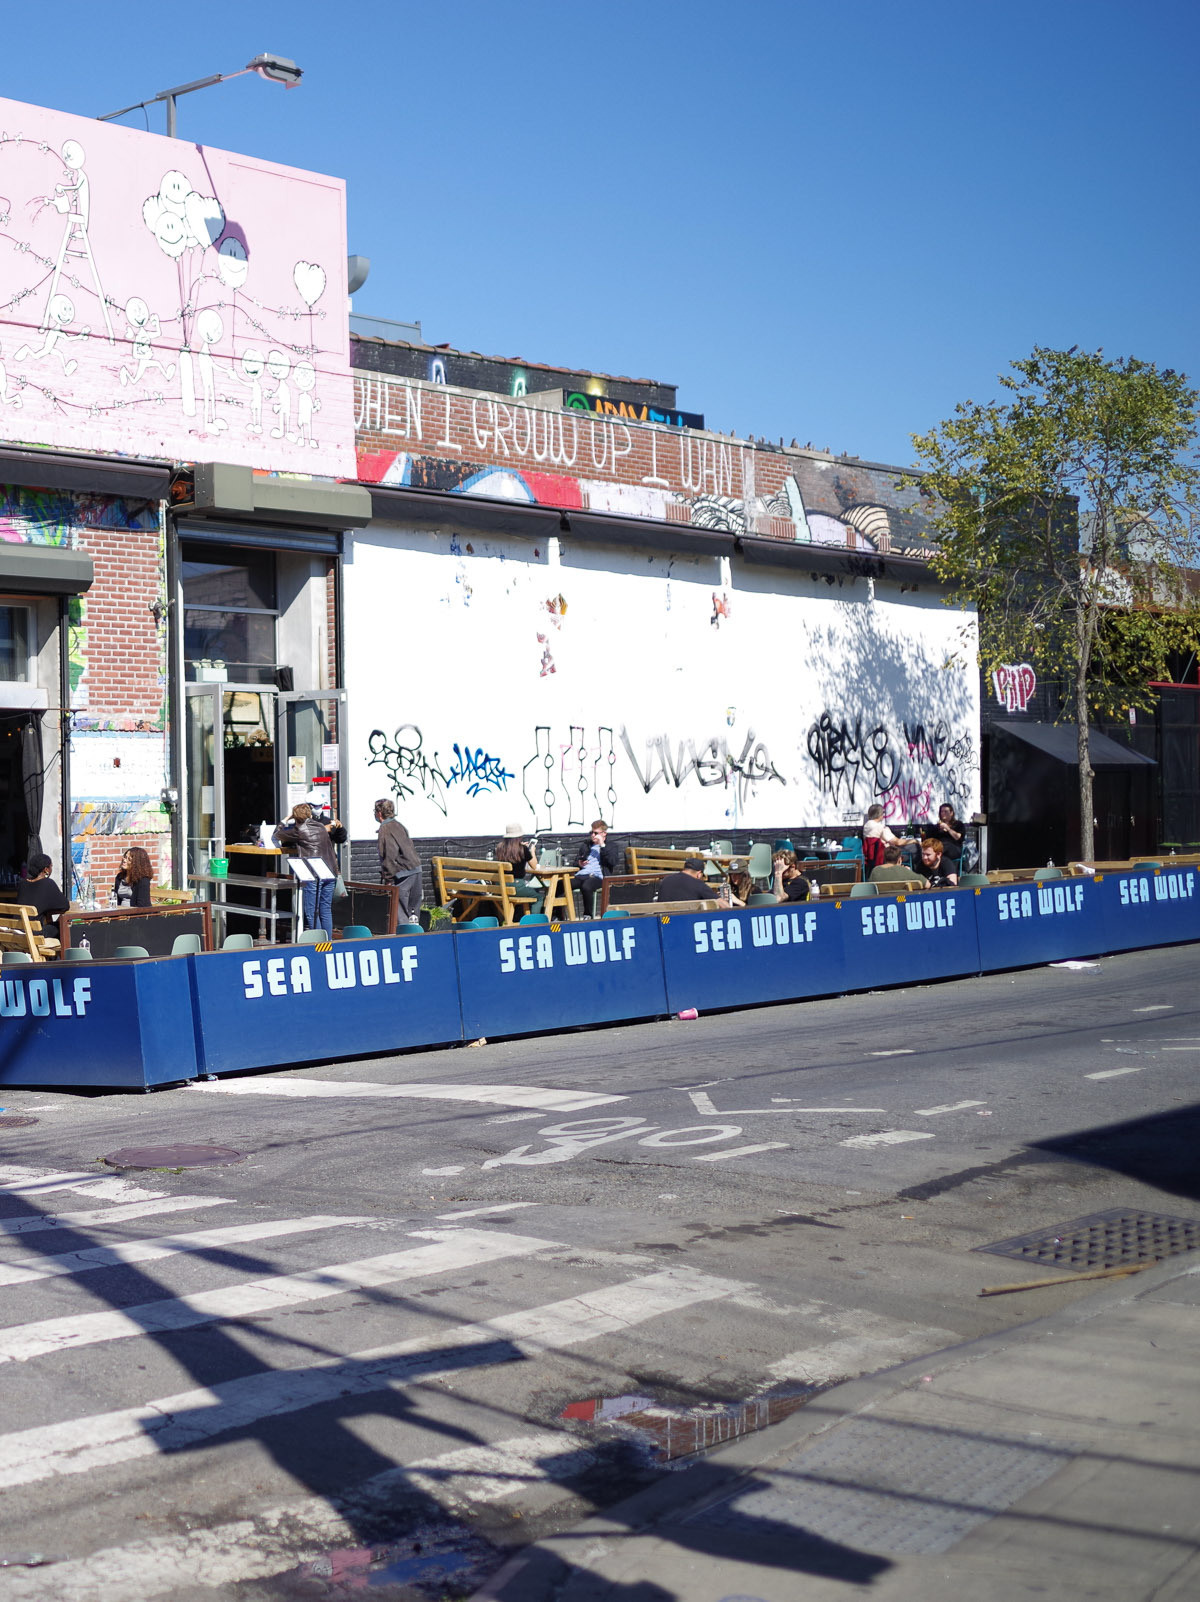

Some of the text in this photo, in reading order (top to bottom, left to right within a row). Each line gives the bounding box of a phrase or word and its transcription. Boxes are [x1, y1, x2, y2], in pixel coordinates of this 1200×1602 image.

[436, 385, 463, 451] I
[591, 415, 632, 475] UP
[641, 421, 670, 487] I
[998, 885, 1084, 920] SEA WOLF
[1119, 873, 1195, 905] SEA WOLF
[693, 911, 817, 953] SEA WOLF
[861, 898, 955, 936] SEA WOLF
[499, 927, 635, 973] SEA WOLF
[242, 945, 418, 999] SEA WOLF
